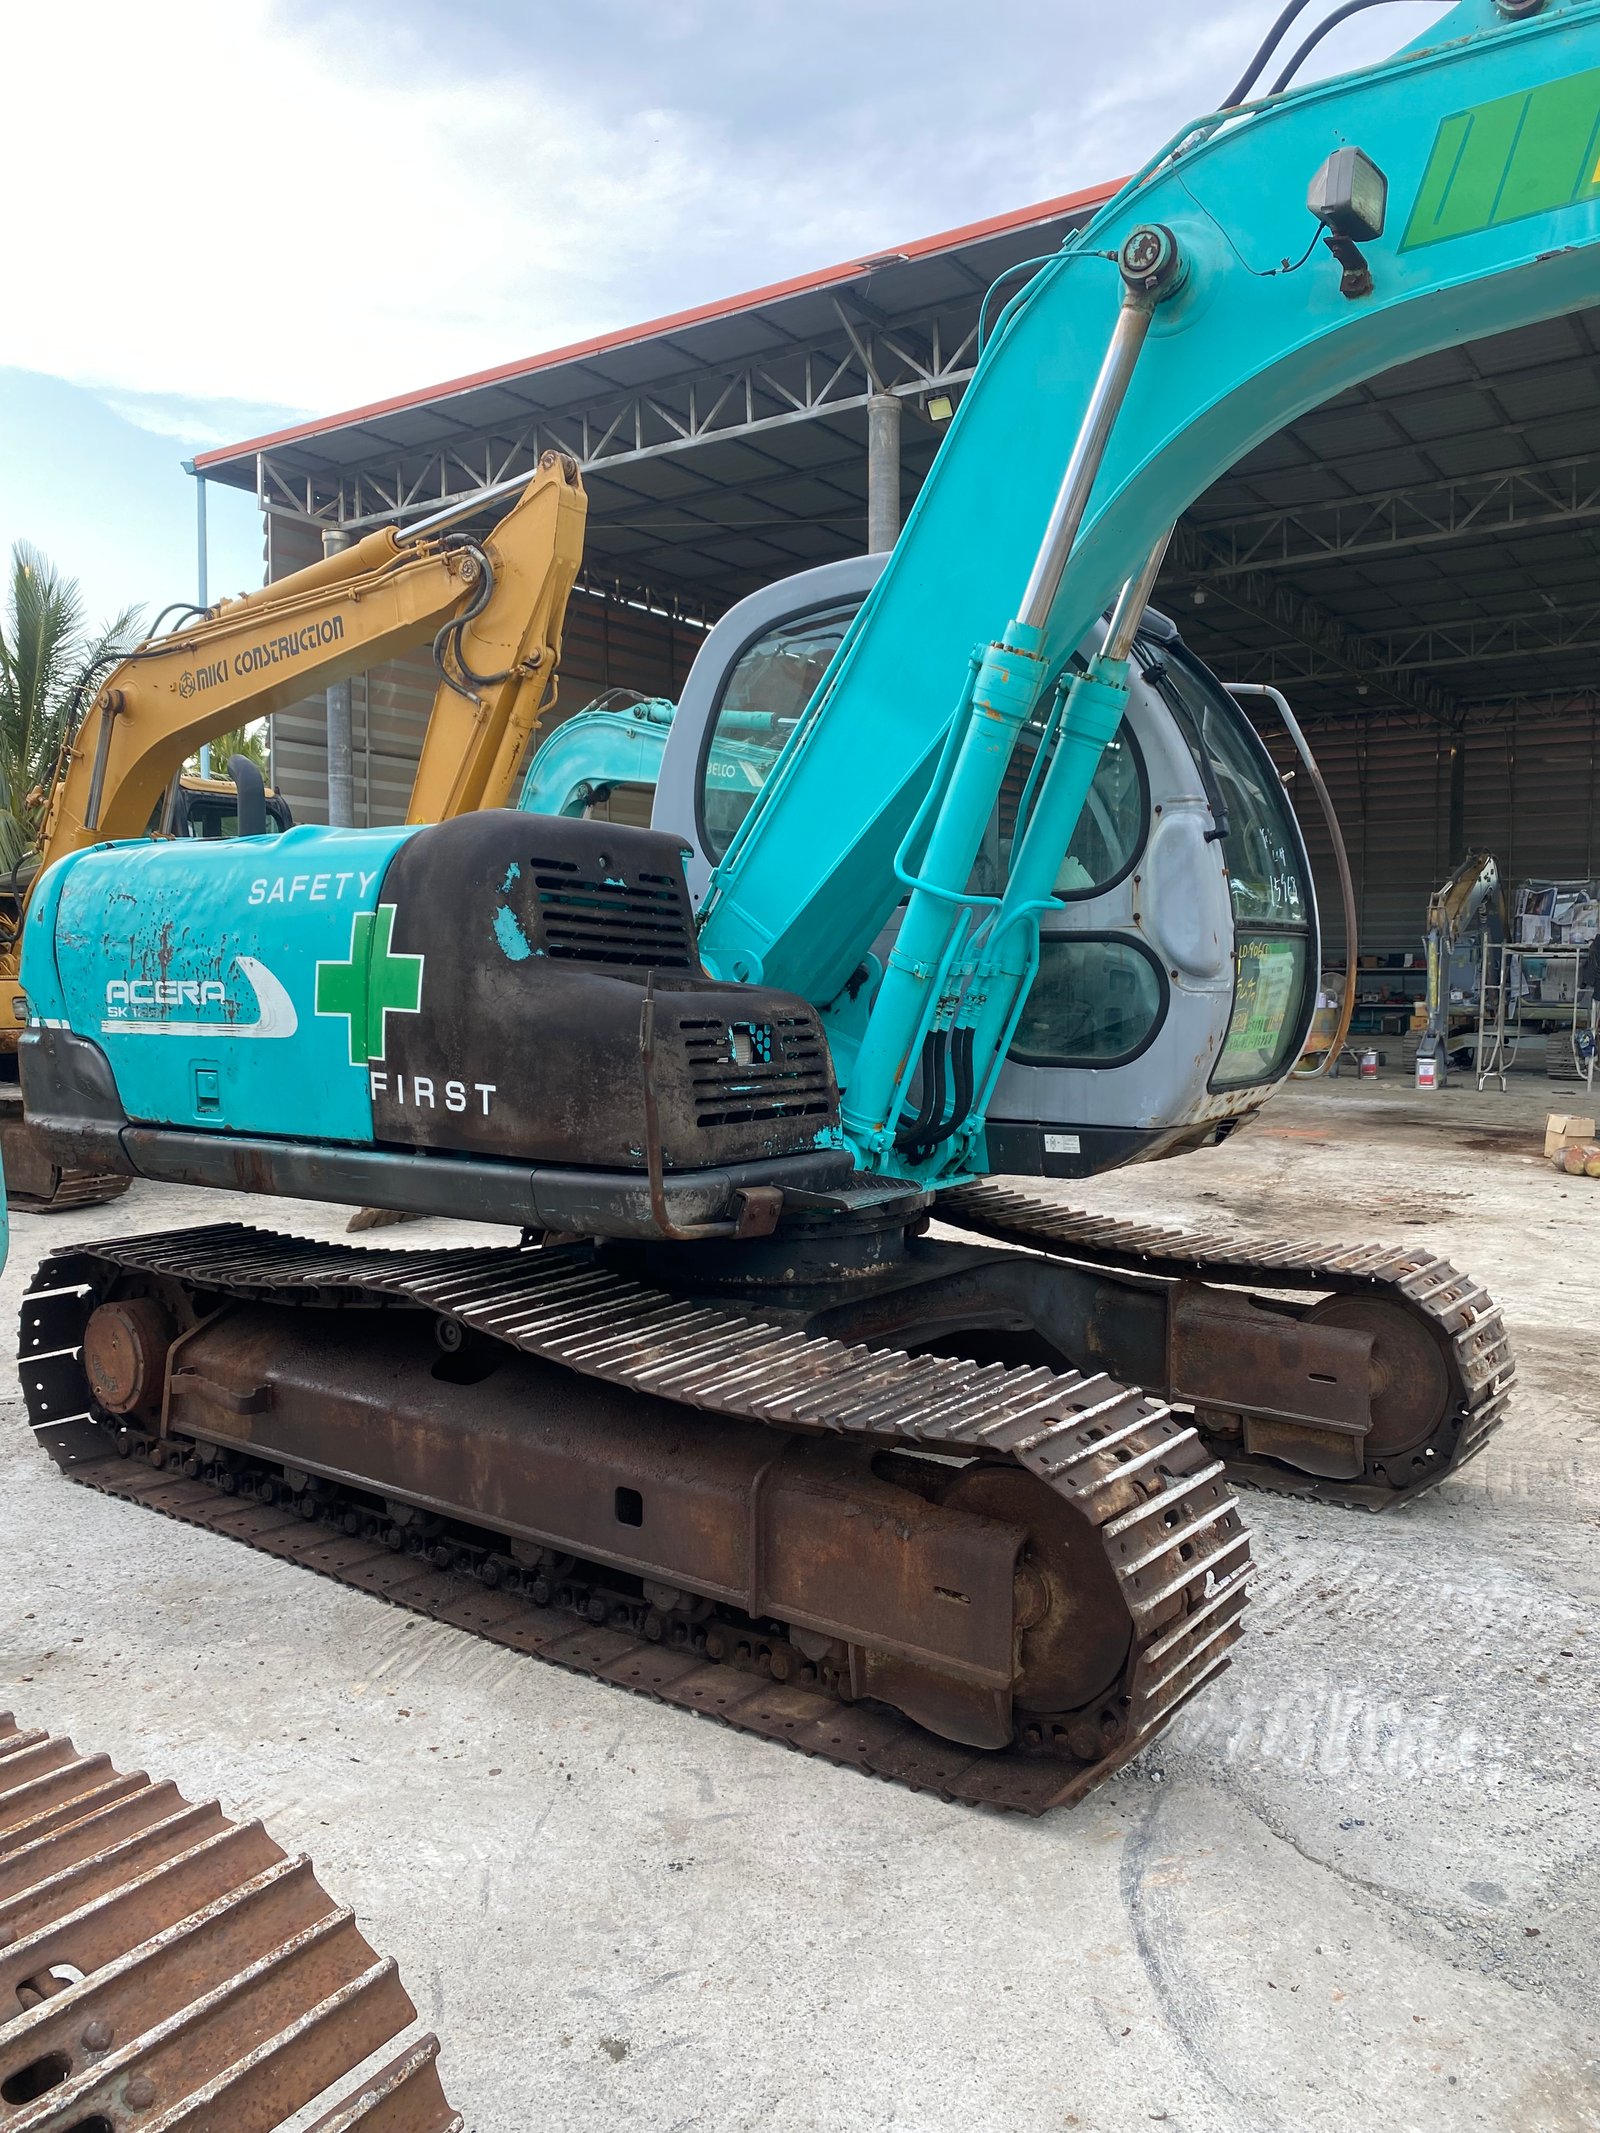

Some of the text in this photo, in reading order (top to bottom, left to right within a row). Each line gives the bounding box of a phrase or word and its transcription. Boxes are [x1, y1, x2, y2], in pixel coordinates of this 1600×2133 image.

[195, 615, 345, 692] MIKI CONSTRUCTION
[248, 871, 377, 905] SAFETY
[106, 979, 226, 1005] ACERA
[107, 1006, 128, 1018] SK
[370, 1071, 497, 1116] FIRST
